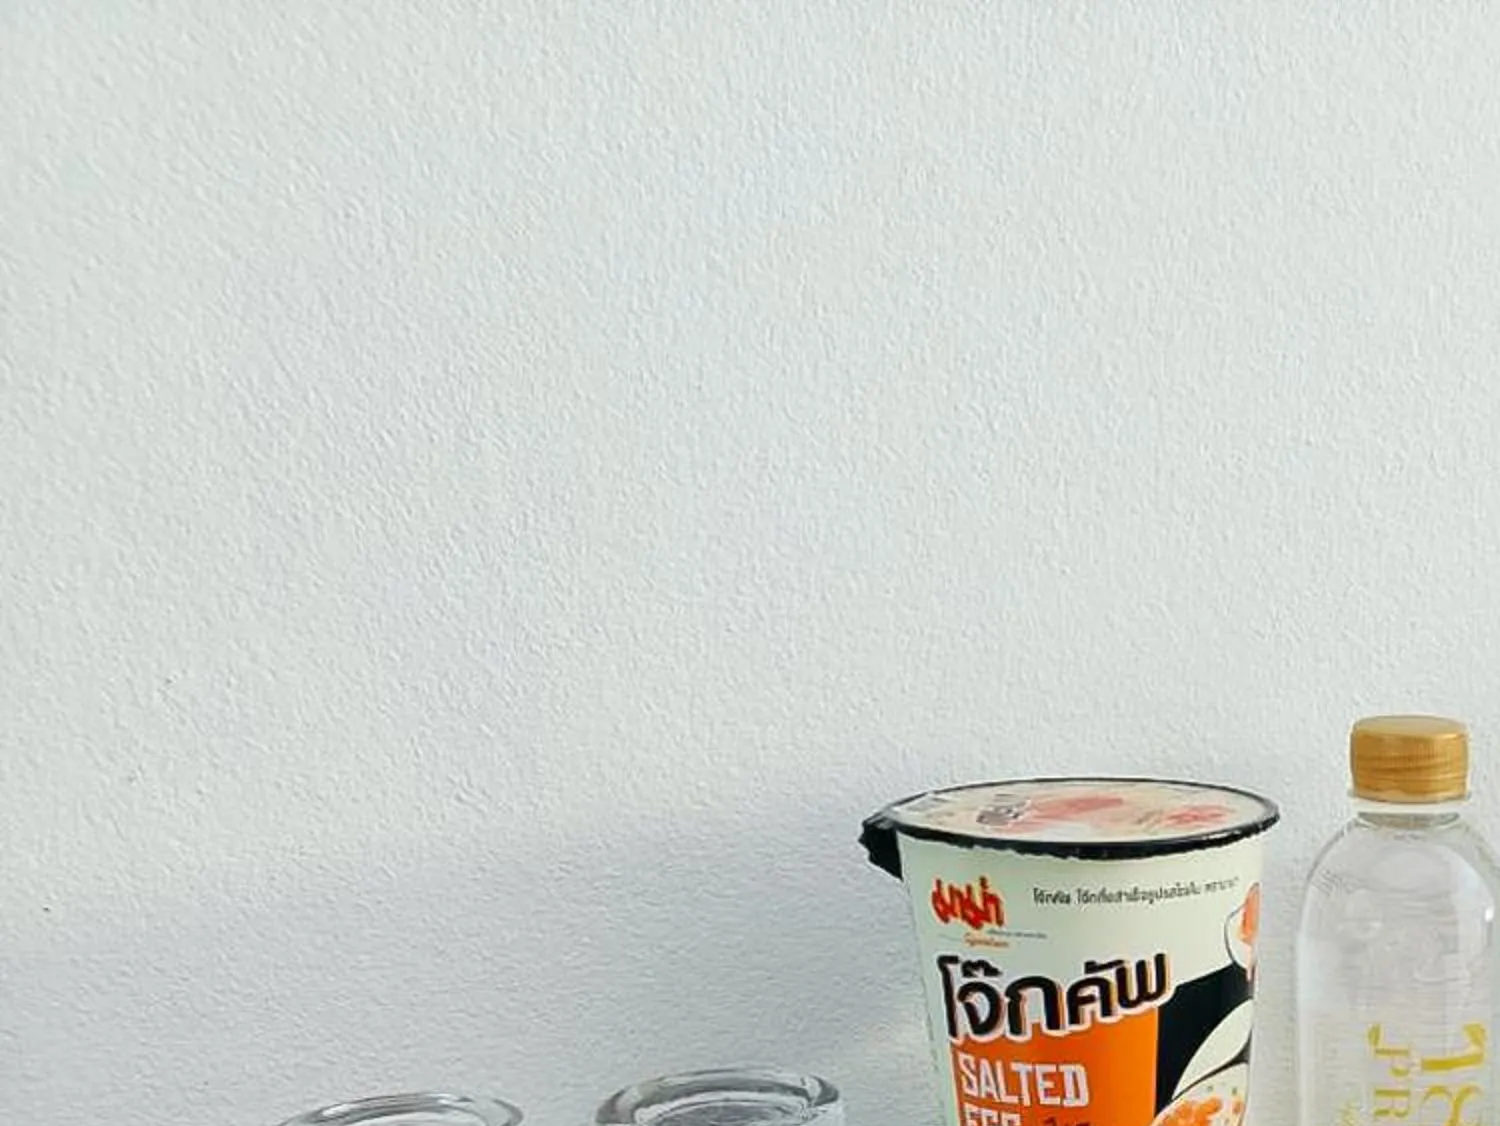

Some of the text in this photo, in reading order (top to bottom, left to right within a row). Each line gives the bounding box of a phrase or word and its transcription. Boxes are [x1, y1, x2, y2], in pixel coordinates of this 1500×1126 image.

[937, 952, 1168, 1040] โจ๊กคัพ
[956, 1053, 1090, 1108] SALTED
